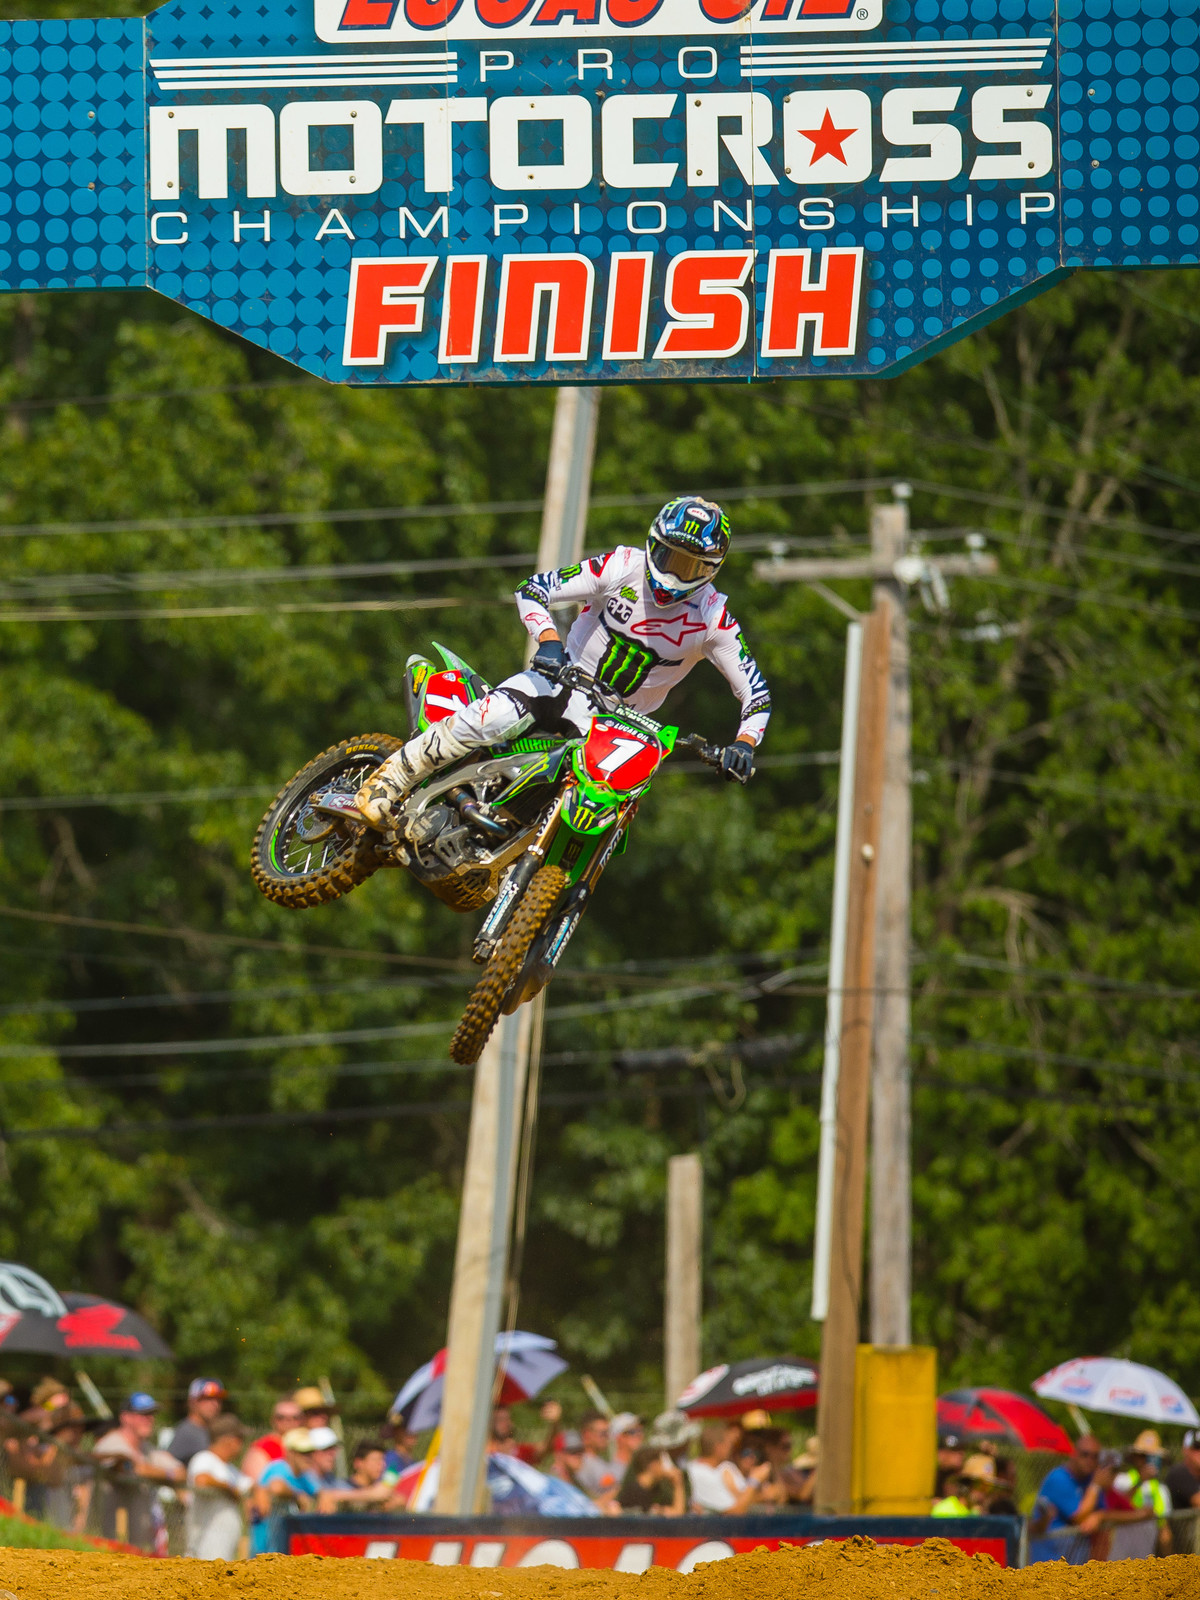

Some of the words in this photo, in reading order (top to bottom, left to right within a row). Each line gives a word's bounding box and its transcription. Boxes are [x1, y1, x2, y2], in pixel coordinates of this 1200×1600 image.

[480, 46, 718, 82] PRO
[150, 85, 1053, 200] MOTOCROSS
[150, 192, 1055, 244] CHAMPIONSHIP
[342, 247, 864, 366] FINISH
[608, 599, 632, 621] PPG
[613, 722, 639, 736] LUCAS
[637, 732, 649, 743] OIL
[596, 737, 647, 773] 1
